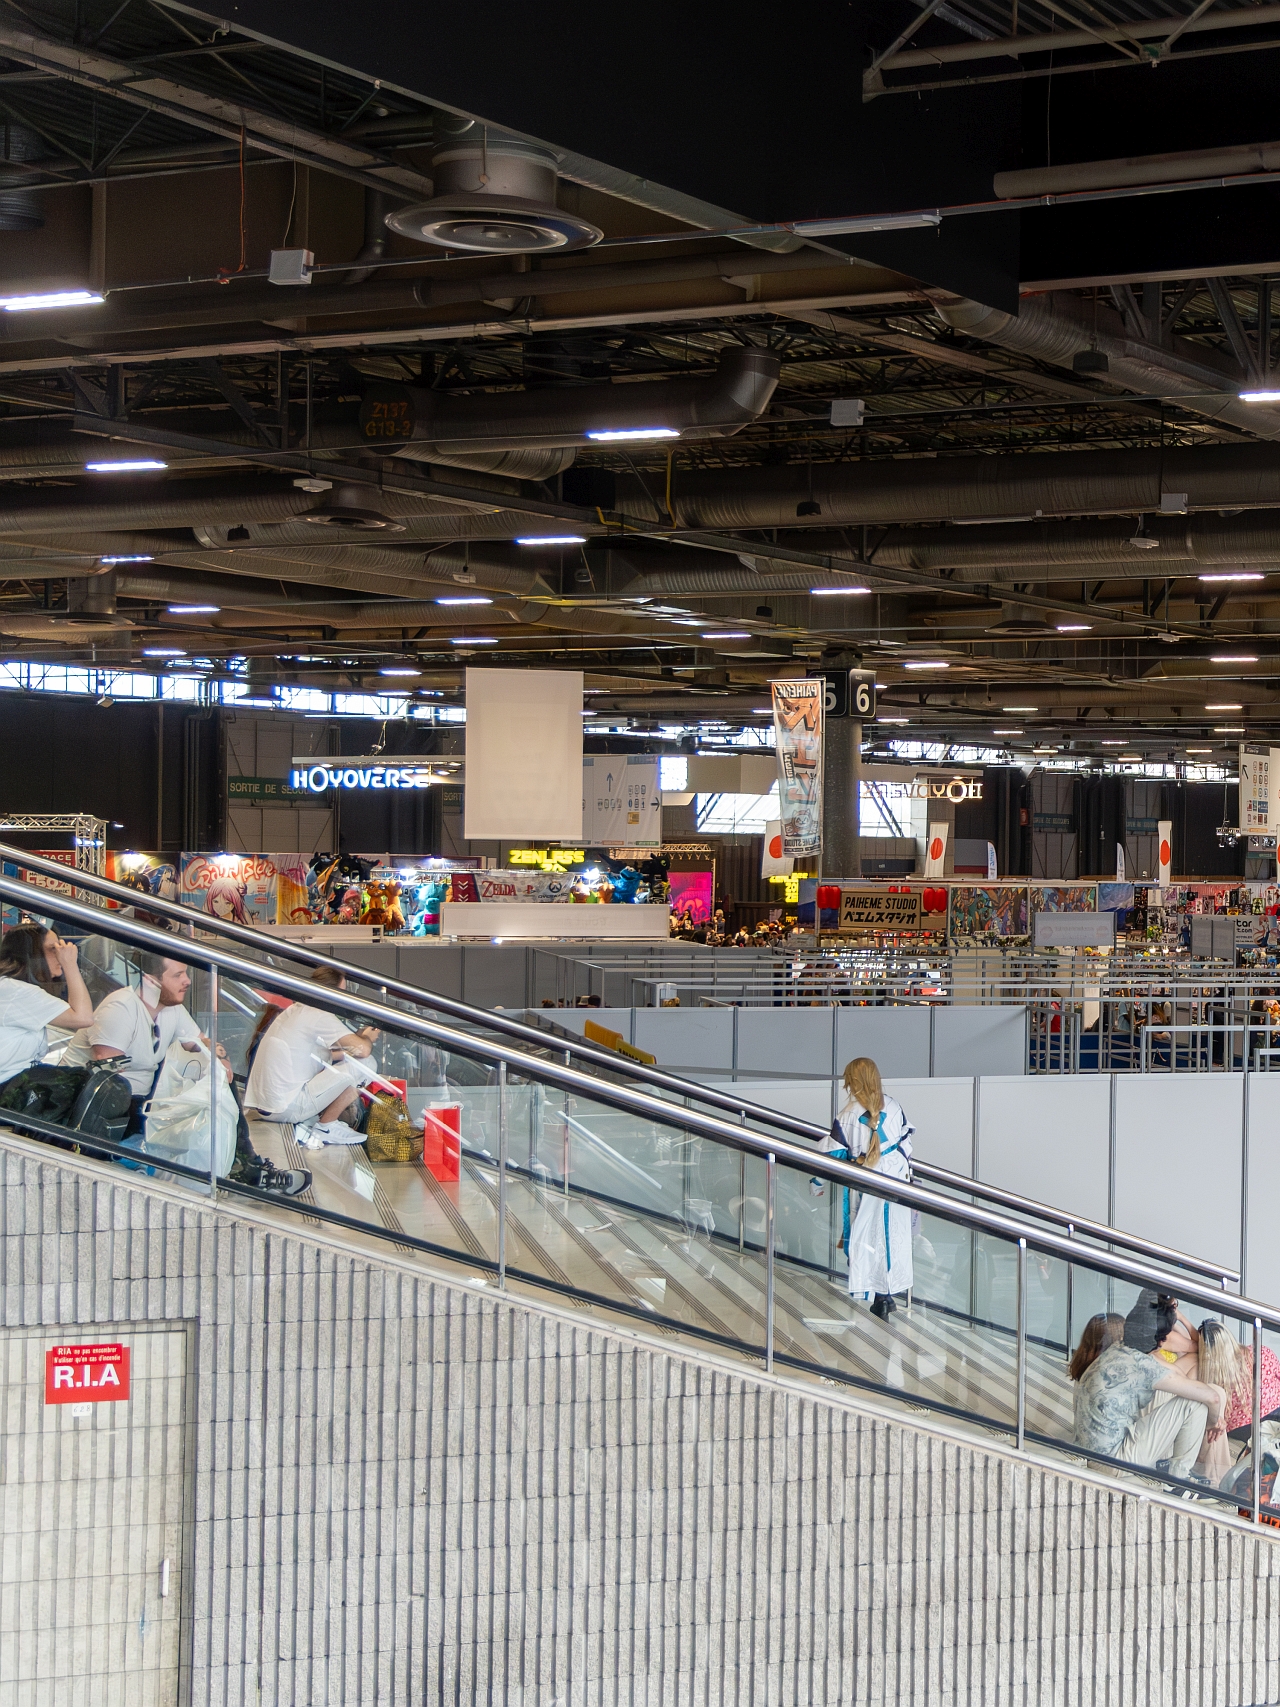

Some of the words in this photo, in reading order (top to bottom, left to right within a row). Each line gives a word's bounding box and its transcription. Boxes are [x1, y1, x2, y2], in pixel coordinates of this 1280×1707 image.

[856, 683, 870, 712] 6
[293, 767, 429, 791] HOYOVERSE
[229, 783, 260, 793] SORTIE
[265, 785, 277, 794] DE
[509, 850, 585, 864] ZENLESS
[481, 880, 518, 898] ZELDA
[845, 897, 881, 910] PAIHEME
[885, 898, 917, 911] STUDIO
[843, 911, 917, 925] ペエムスタジオ
[58, 1347, 72, 1355] RIA
[54, 1363, 120, 1389] R.I.A
